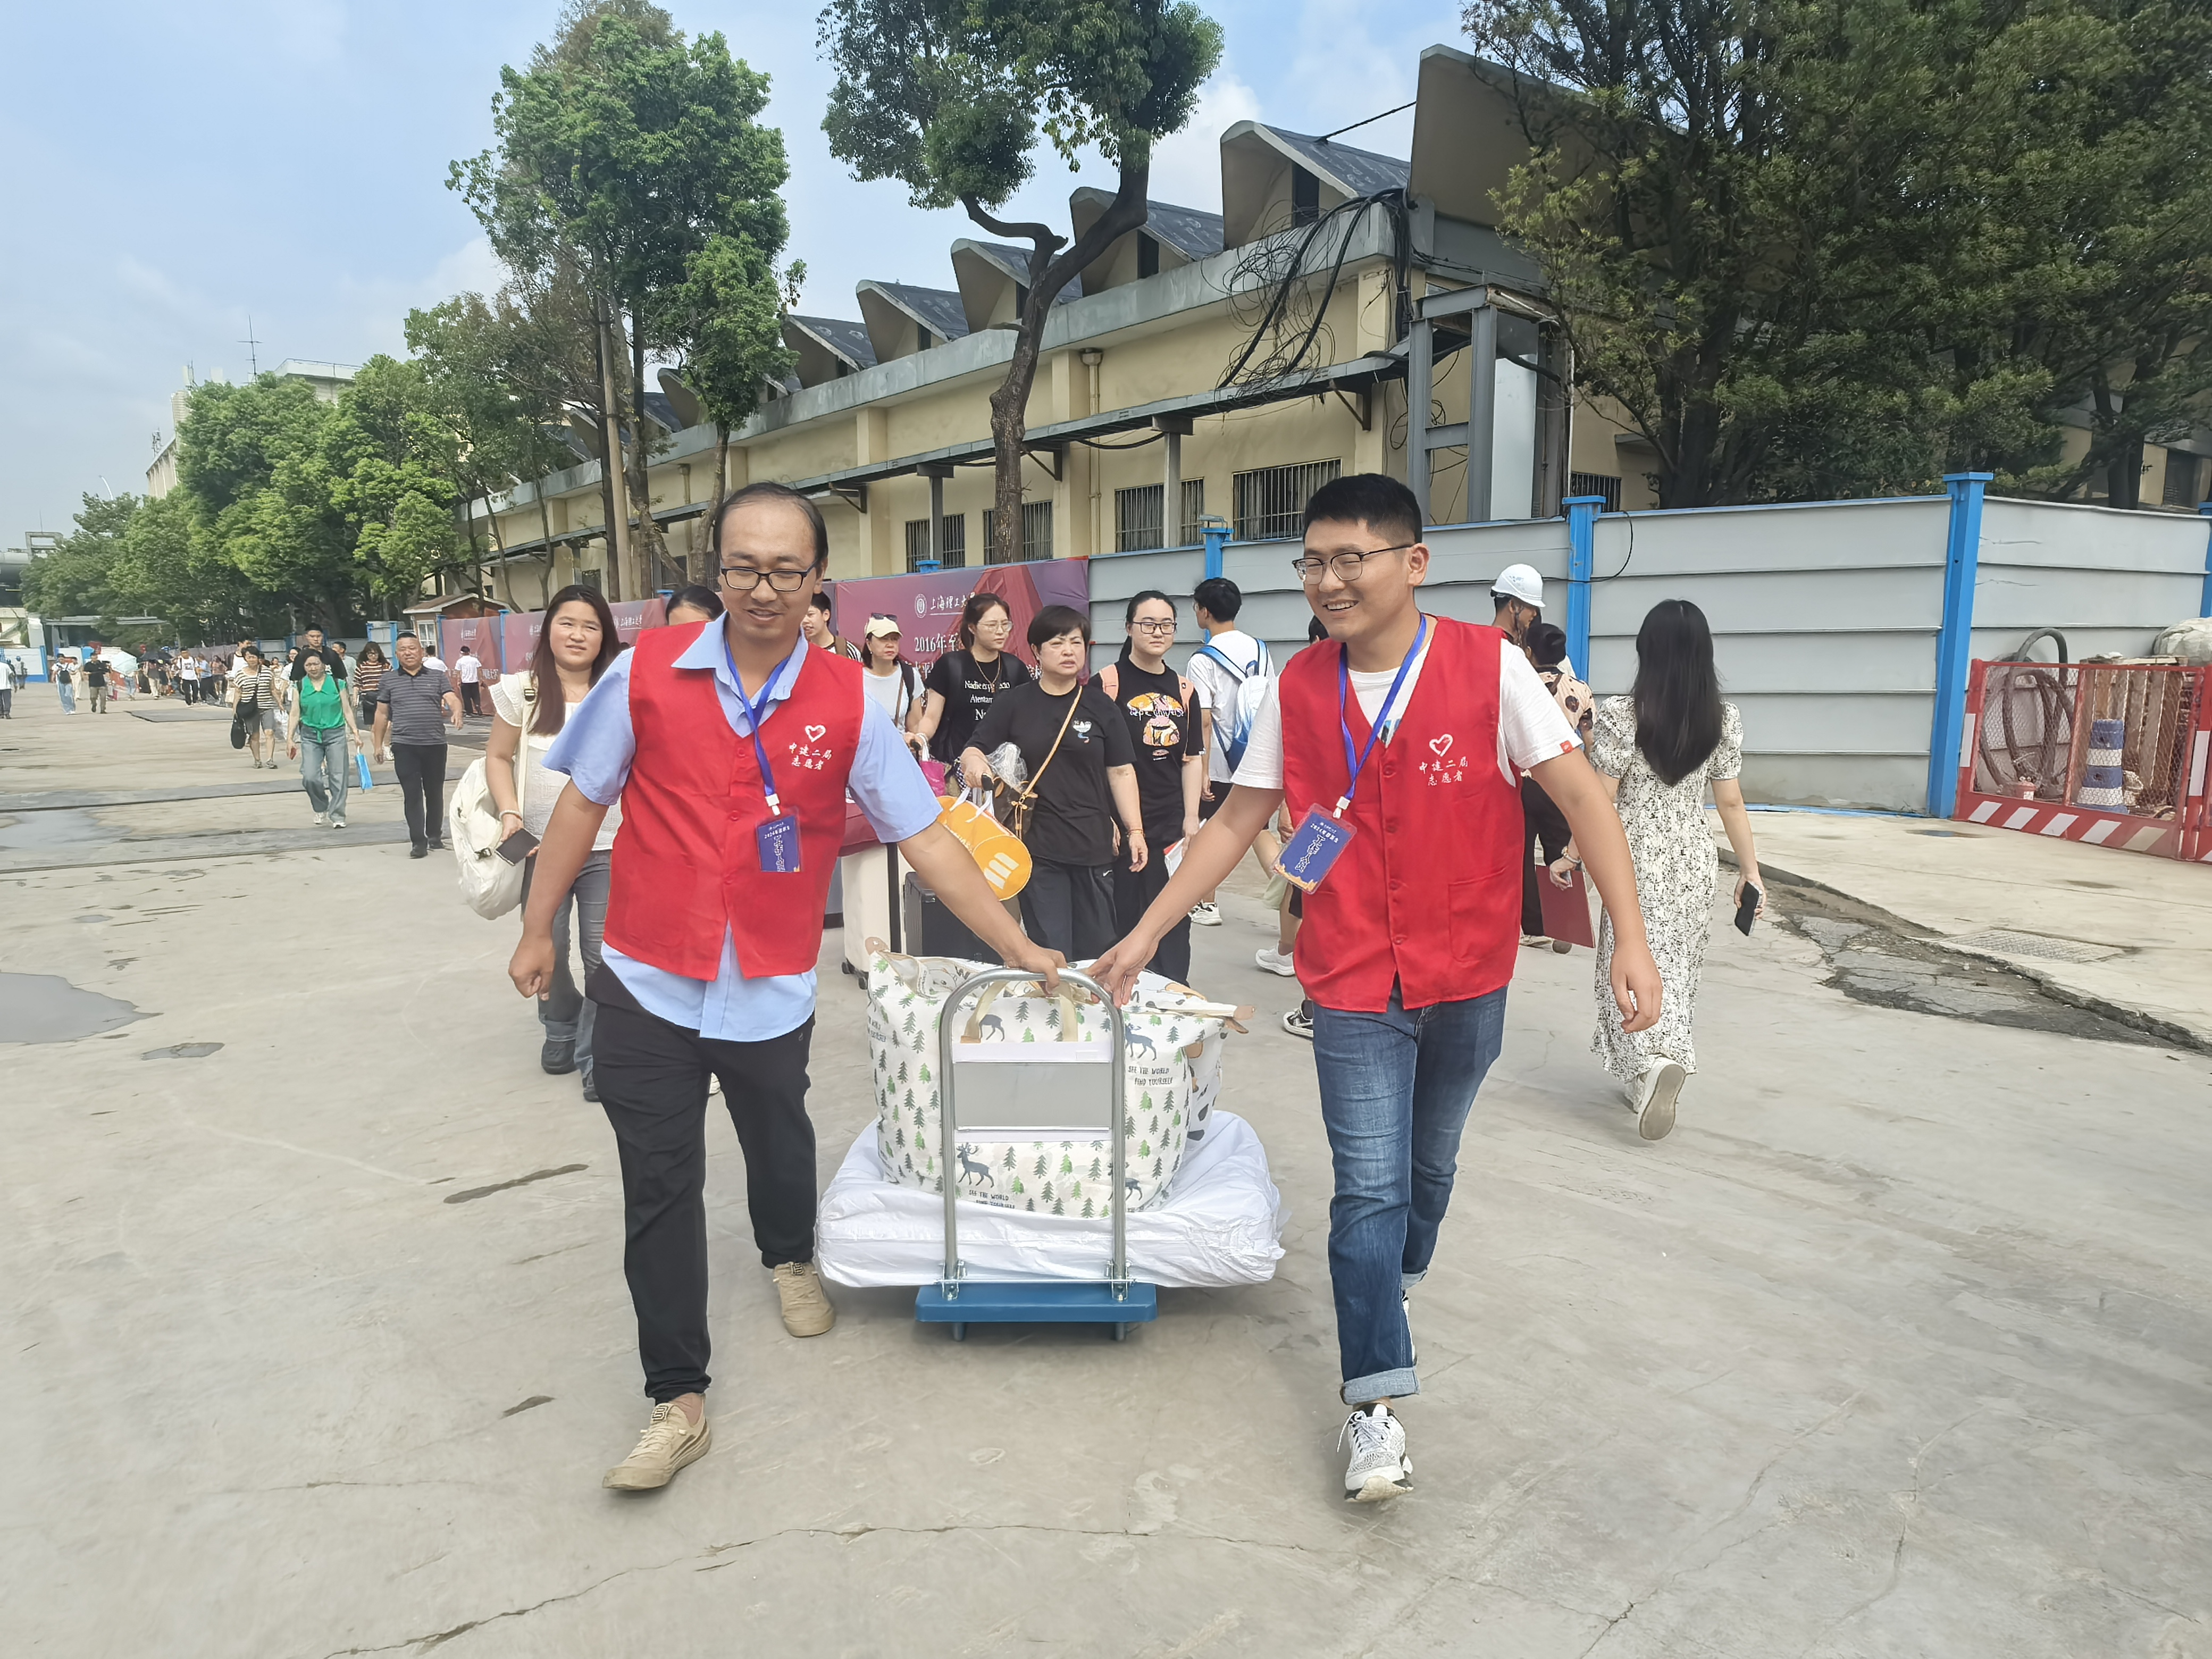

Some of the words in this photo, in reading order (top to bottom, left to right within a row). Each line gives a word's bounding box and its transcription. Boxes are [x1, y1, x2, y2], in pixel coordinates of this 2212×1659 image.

[1419, 756, 1468, 774] 中建二局
[1428, 769, 1463, 786] 志愿者
